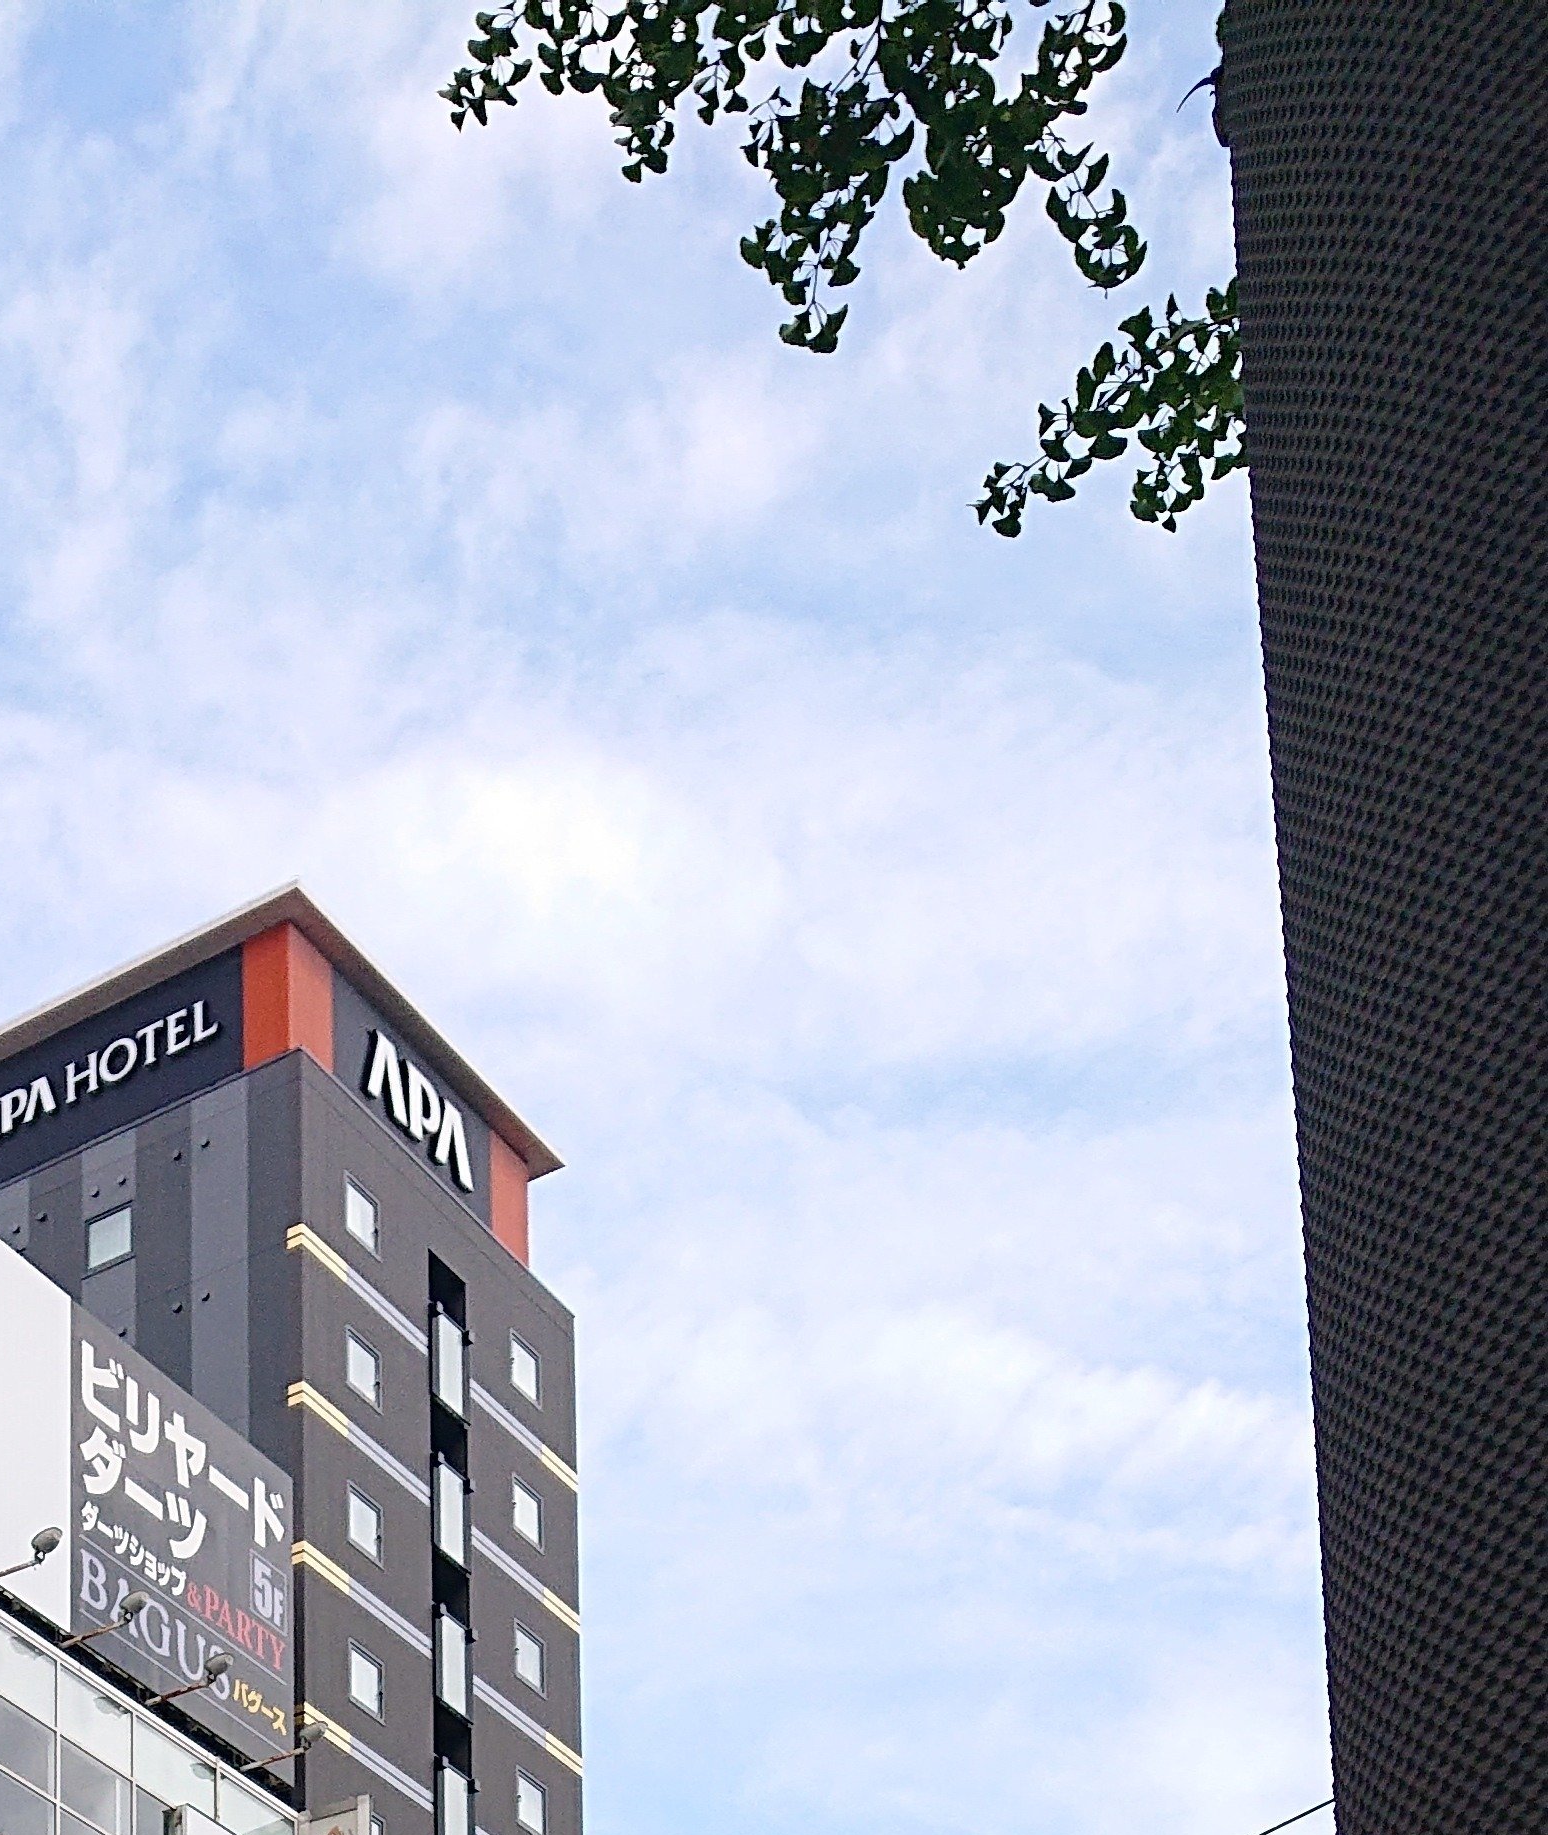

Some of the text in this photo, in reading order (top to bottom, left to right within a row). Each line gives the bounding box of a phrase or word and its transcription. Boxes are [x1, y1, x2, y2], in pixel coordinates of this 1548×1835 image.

[64, 1000, 219, 1103] HOTEL
[366, 1030, 474, 1192] APA
[80, 1427, 207, 1560] ダーツ
[81, 1340, 285, 1548] ビリヤード
[80, 1501, 187, 1597] ダーツショップ
